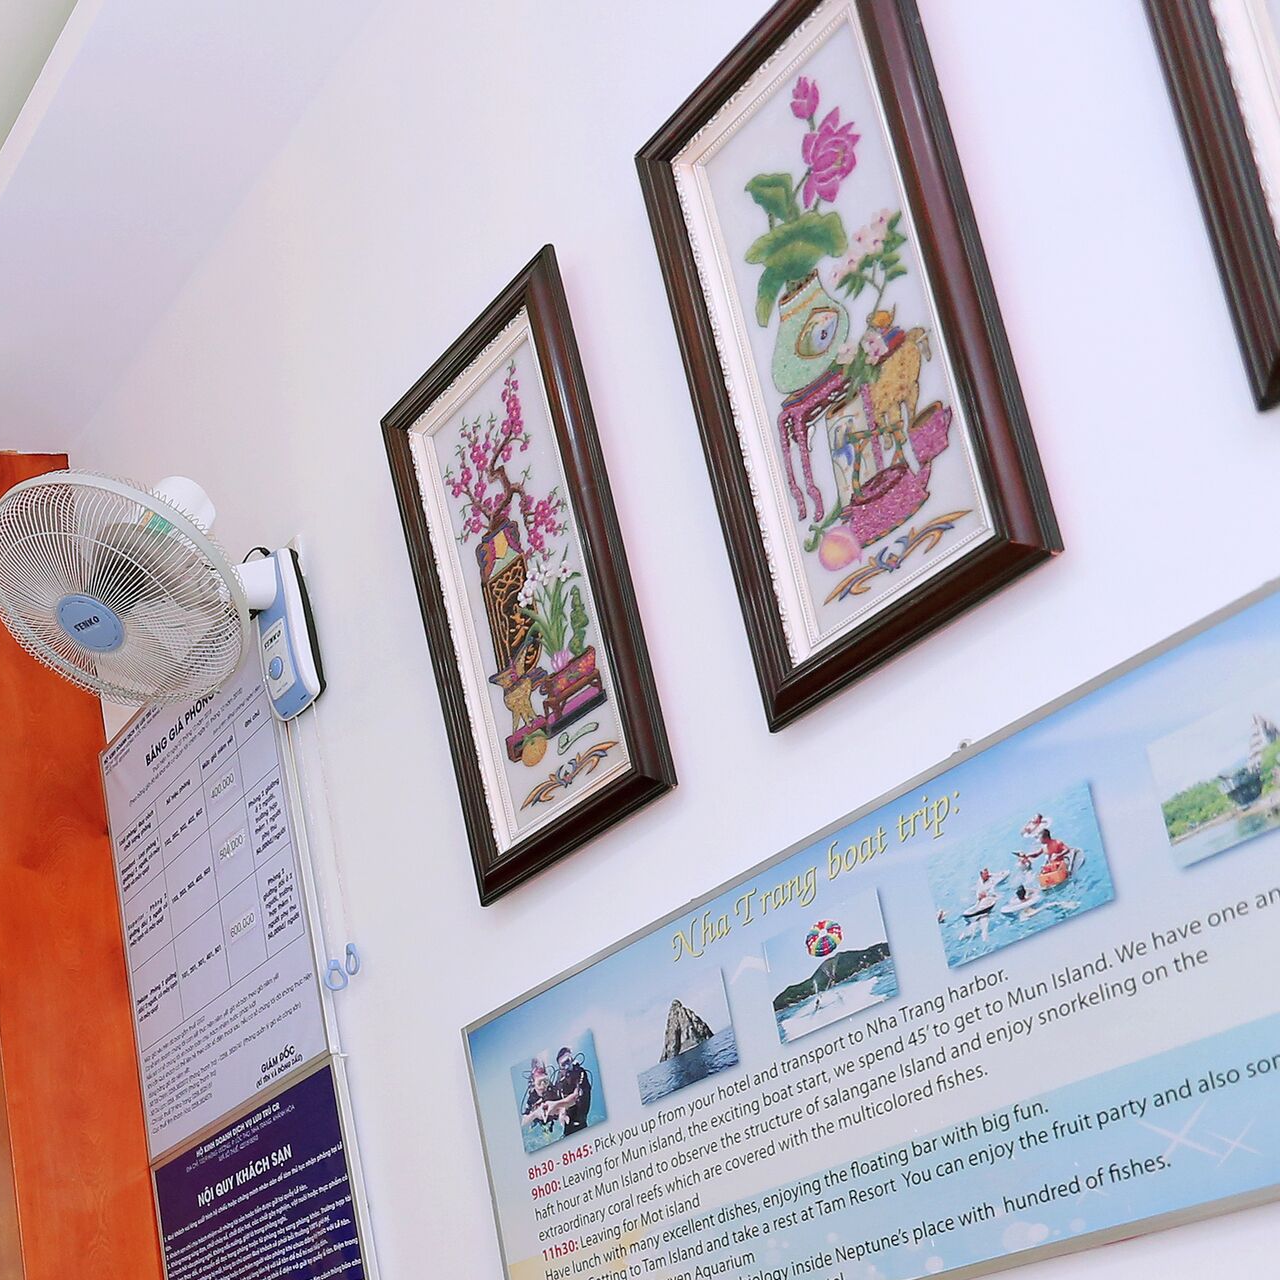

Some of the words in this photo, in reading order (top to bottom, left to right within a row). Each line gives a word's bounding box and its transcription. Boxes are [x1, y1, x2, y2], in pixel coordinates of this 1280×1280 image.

[73, 616, 100, 633] SENKO
[671, 910, 732, 962] Nha
[734, 866, 817, 926] Trang
[827, 826, 888, 880] boat
[896, 790, 960, 842] trip:
[528, 1159, 554, 1180] 8h30
[561, 1143, 593, 1165] 8h45:
[594, 1132, 616, 1152] Pick
[617, 1125, 638, 1146] you
[640, 1118, 656, 1133] up
[657, 1106, 686, 1125] from
[687, 1092, 715, 1117] your
[717, 1073, 750, 1100] hotel
[753, 1061, 778, 1085] and
[780, 1036, 845, 1073] transport
[847, 1030, 863, 1045] to
[866, 1016, 897, 1037] Nha
[898, 995, 945, 1022] Trang
[947, 969, 1008, 1003] harbor.
[538, 1207, 605, 1241] extraordinary
[607, 1193, 634, 1215] coral
[636, 1183, 663, 1205] reefs
[664, 1169, 701, 1193] which
[703, 1164, 722, 1180] are
[725, 1139, 776, 1171] covered
[777, 1129, 808, 1151] with
[811, 1121, 835, 1139] the
[837, 1079, 933, 1129] multicolored
[936, 1064, 988, 1092] fishes.
[197, 1186, 215, 1208] NỘI
[215, 1175, 234, 1198] QUY
[235, 1156, 270, 1186] KHÁCH
[271, 1143, 293, 1167] SẠN
[542, 1239, 579, 1261] 11h30:
[579, 1225, 621, 1248] Leaving
[622, 1218, 638, 1232] for
[640, 1208, 664, 1227] Mot
[664, 1192, 700, 1218] island
[571, 1252, 601, 1273] lunch
[602, 1243, 627, 1262] with
[629, 1234, 659, 1254] many
[662, 1213, 715, 1242] excellent
[717, 1201, 760, 1223] dishes,
[762, 1178, 821, 1208] enjoying
[823, 1169, 848, 1187] the
[850, 1148, 908, 1178] floating
[911, 1138, 937, 1157] bar
[940, 1121, 978, 1146] with
[980, 1113, 1010, 1133] big
[1013, 1102, 1048, 1122] fun.
